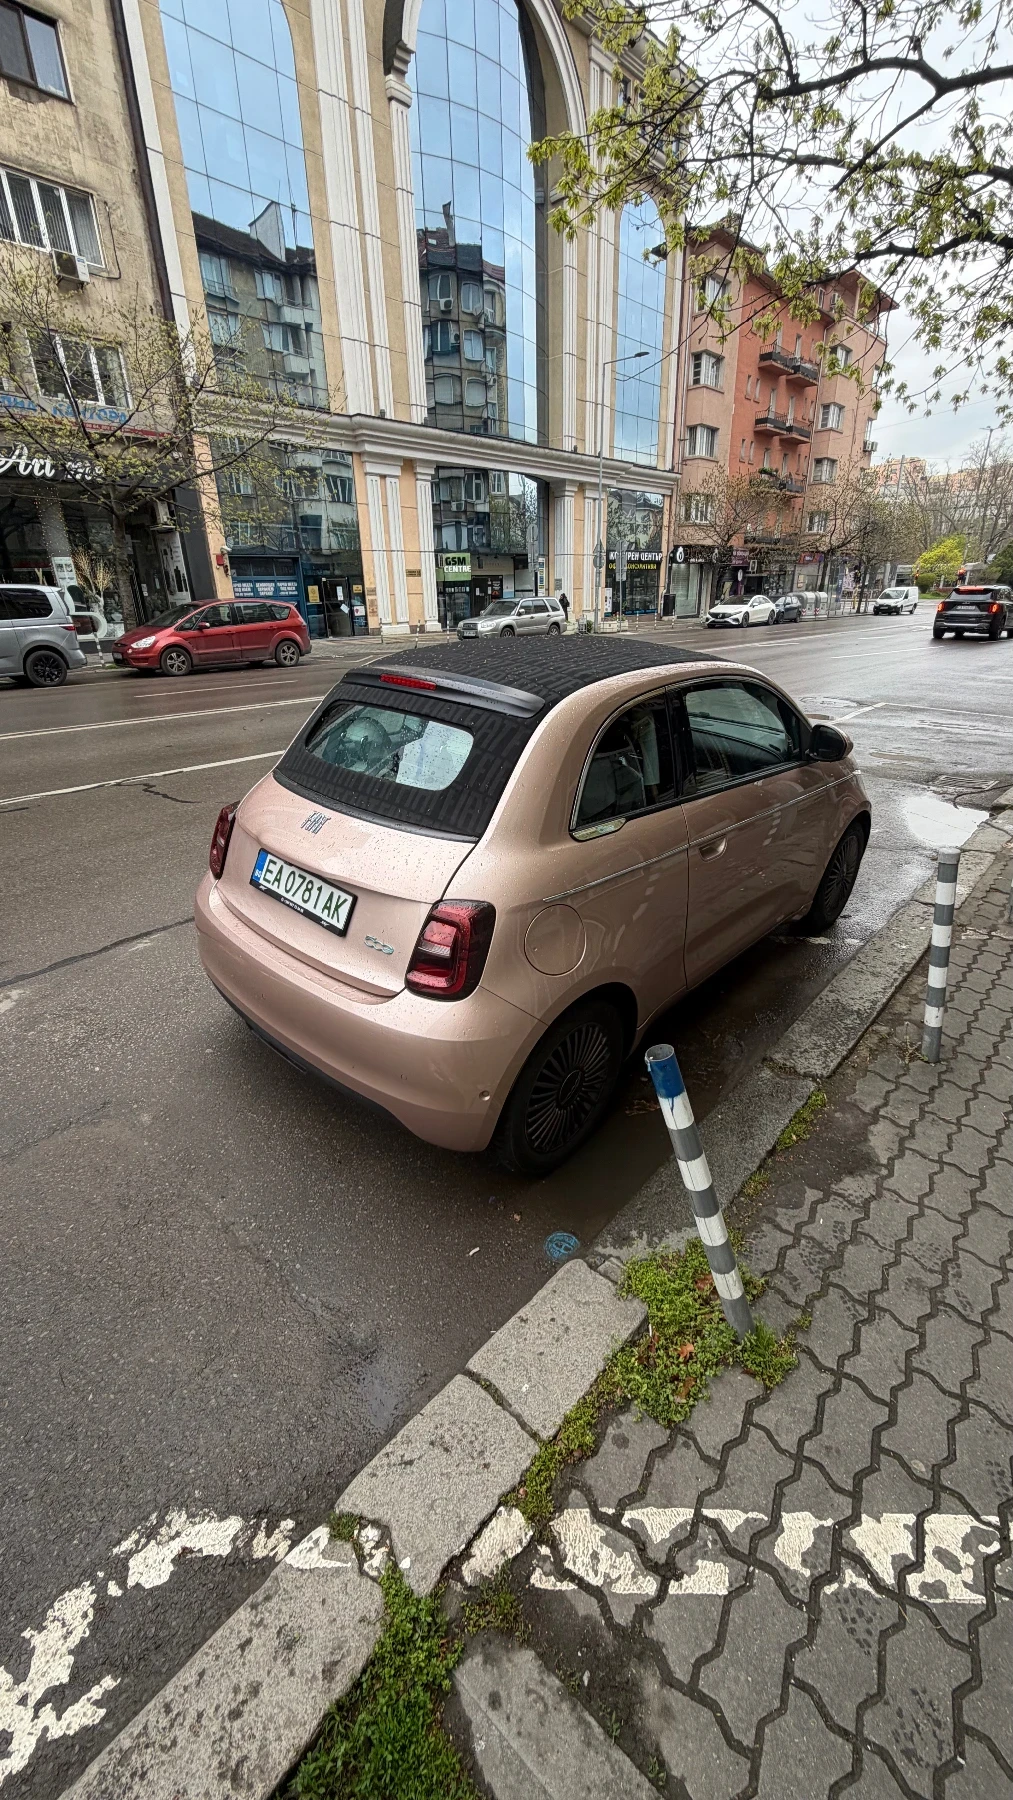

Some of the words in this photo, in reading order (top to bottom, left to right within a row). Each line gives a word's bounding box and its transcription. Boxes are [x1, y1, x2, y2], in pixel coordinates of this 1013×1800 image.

[445, 556, 466, 566] GSM
[640, 552, 663, 561] ЦЕНТЪР
[444, 565, 472, 573] CENTRE
